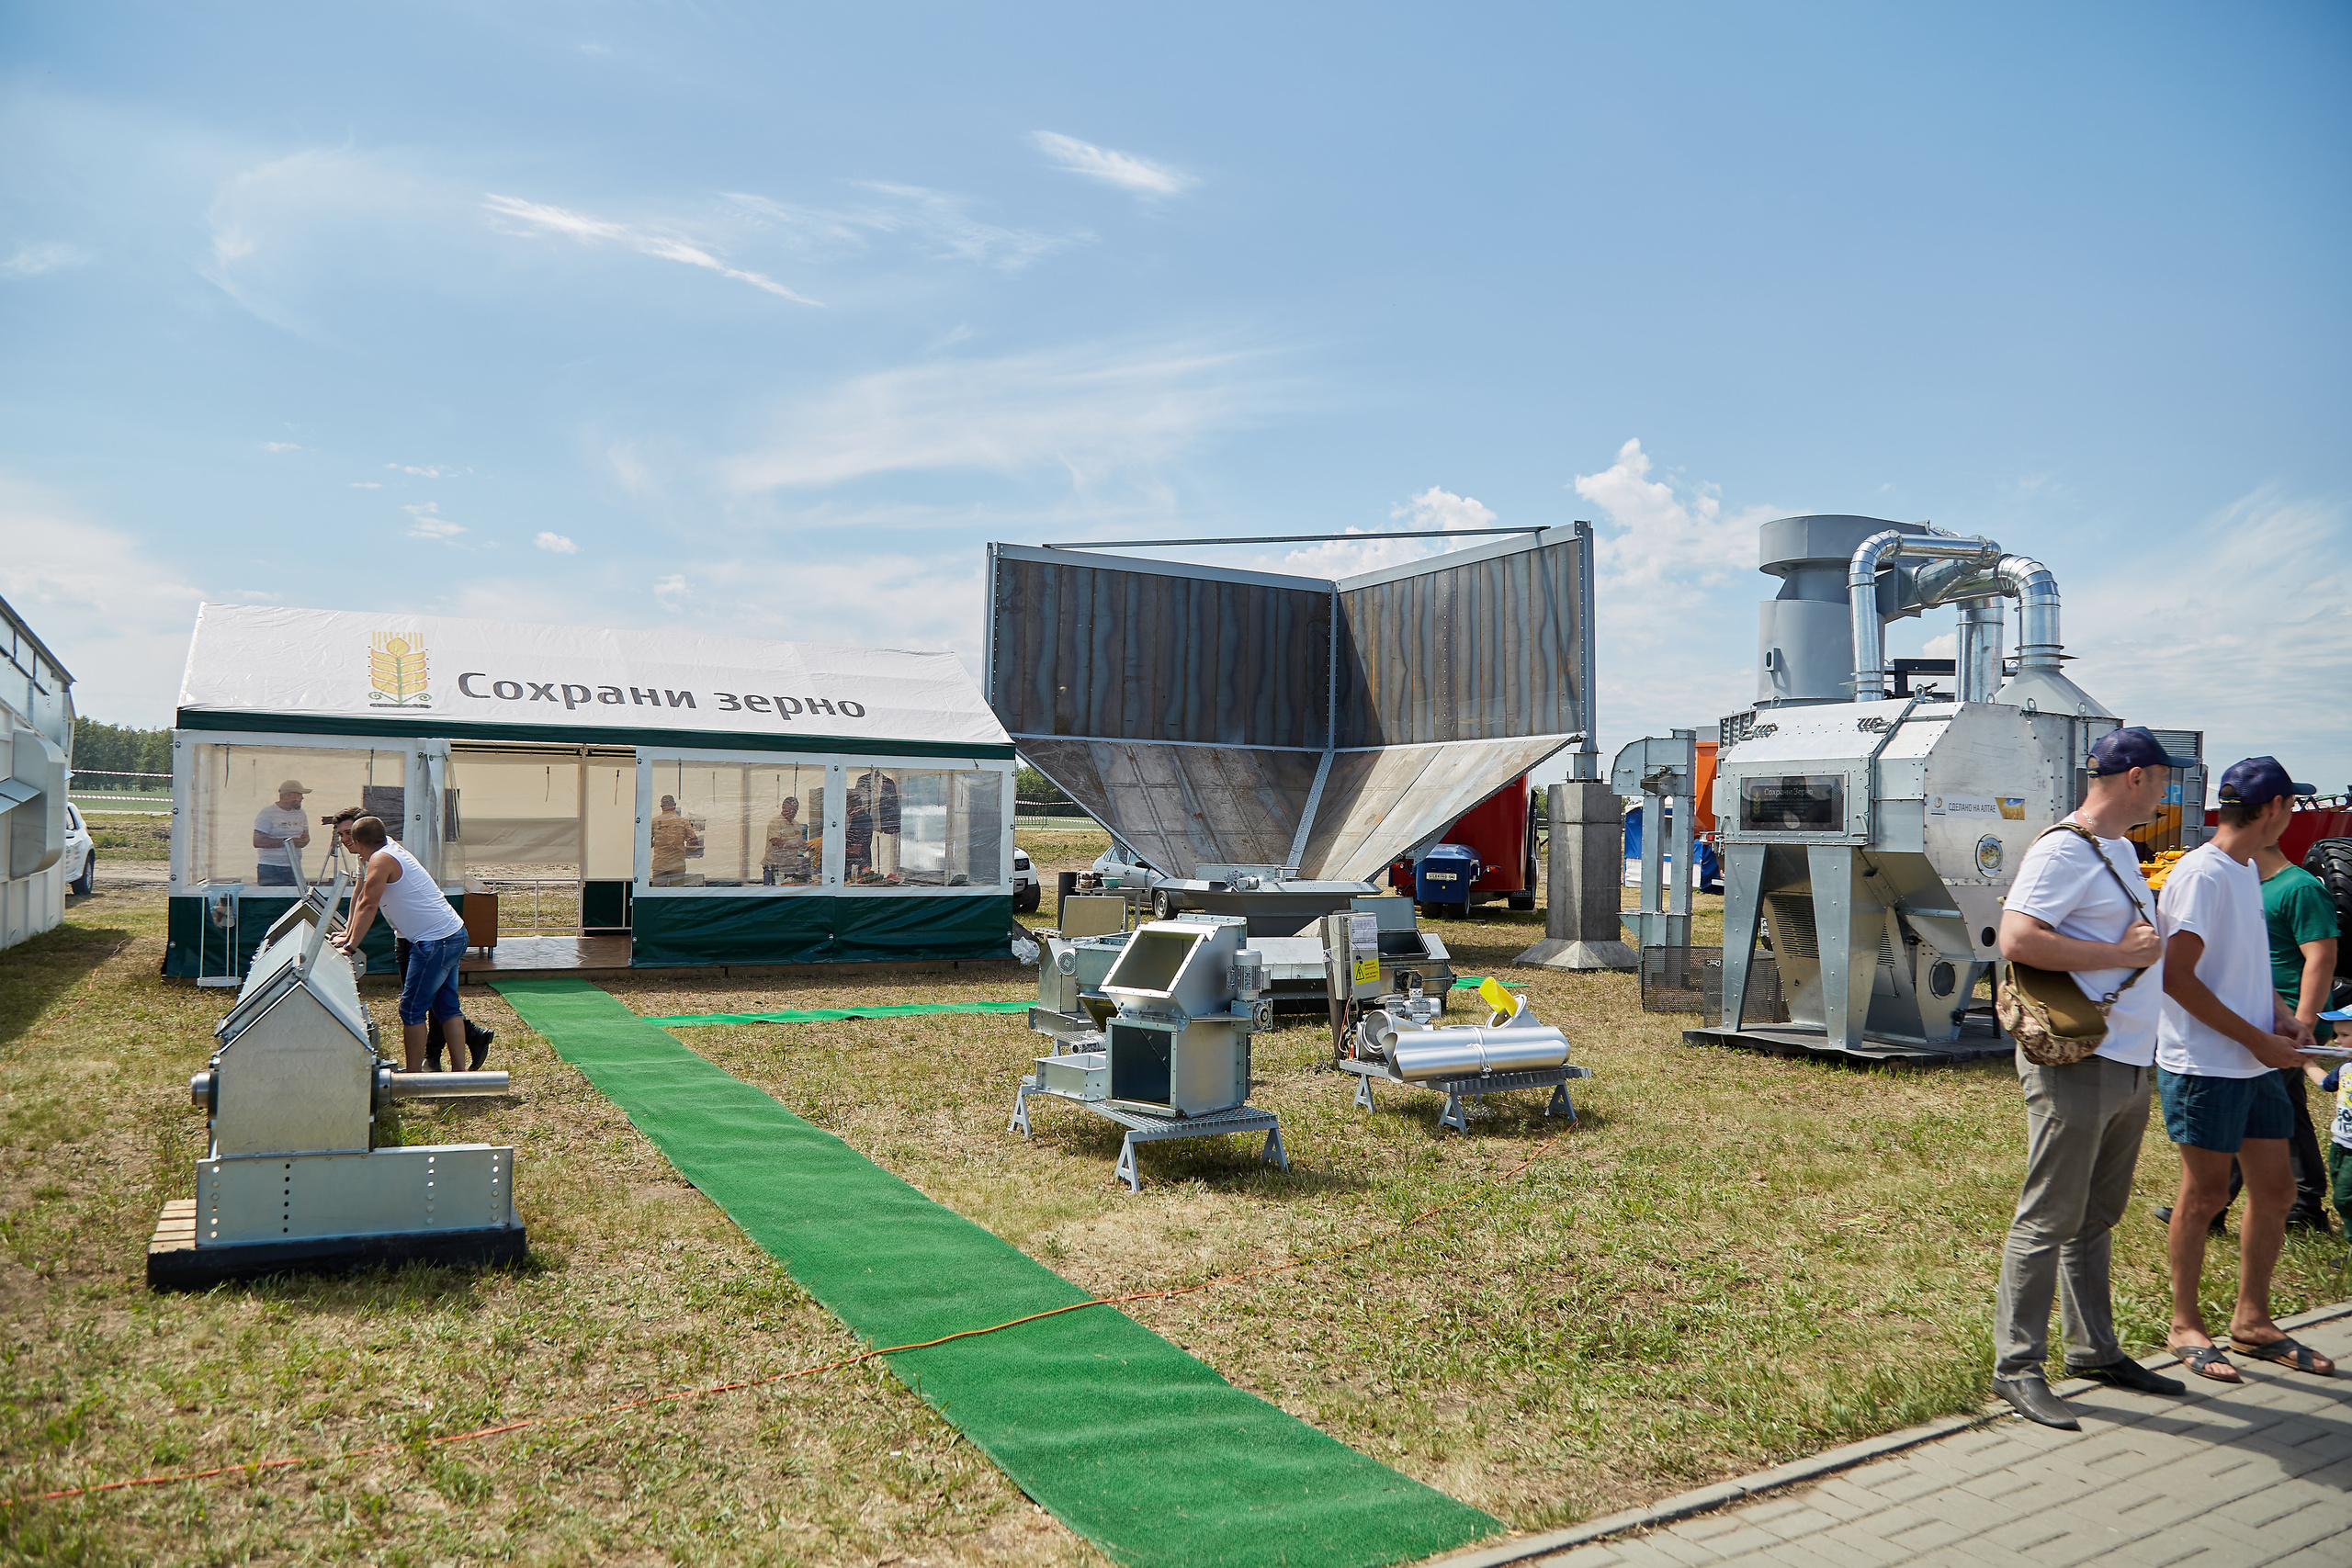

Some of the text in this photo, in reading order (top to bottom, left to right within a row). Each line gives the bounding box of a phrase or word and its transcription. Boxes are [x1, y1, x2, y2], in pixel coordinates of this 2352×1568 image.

[458, 671, 865, 721] Сохрани зерно
[1948, 802, 1996, 813] СДЕЛАНО НА АЛТАЕ
